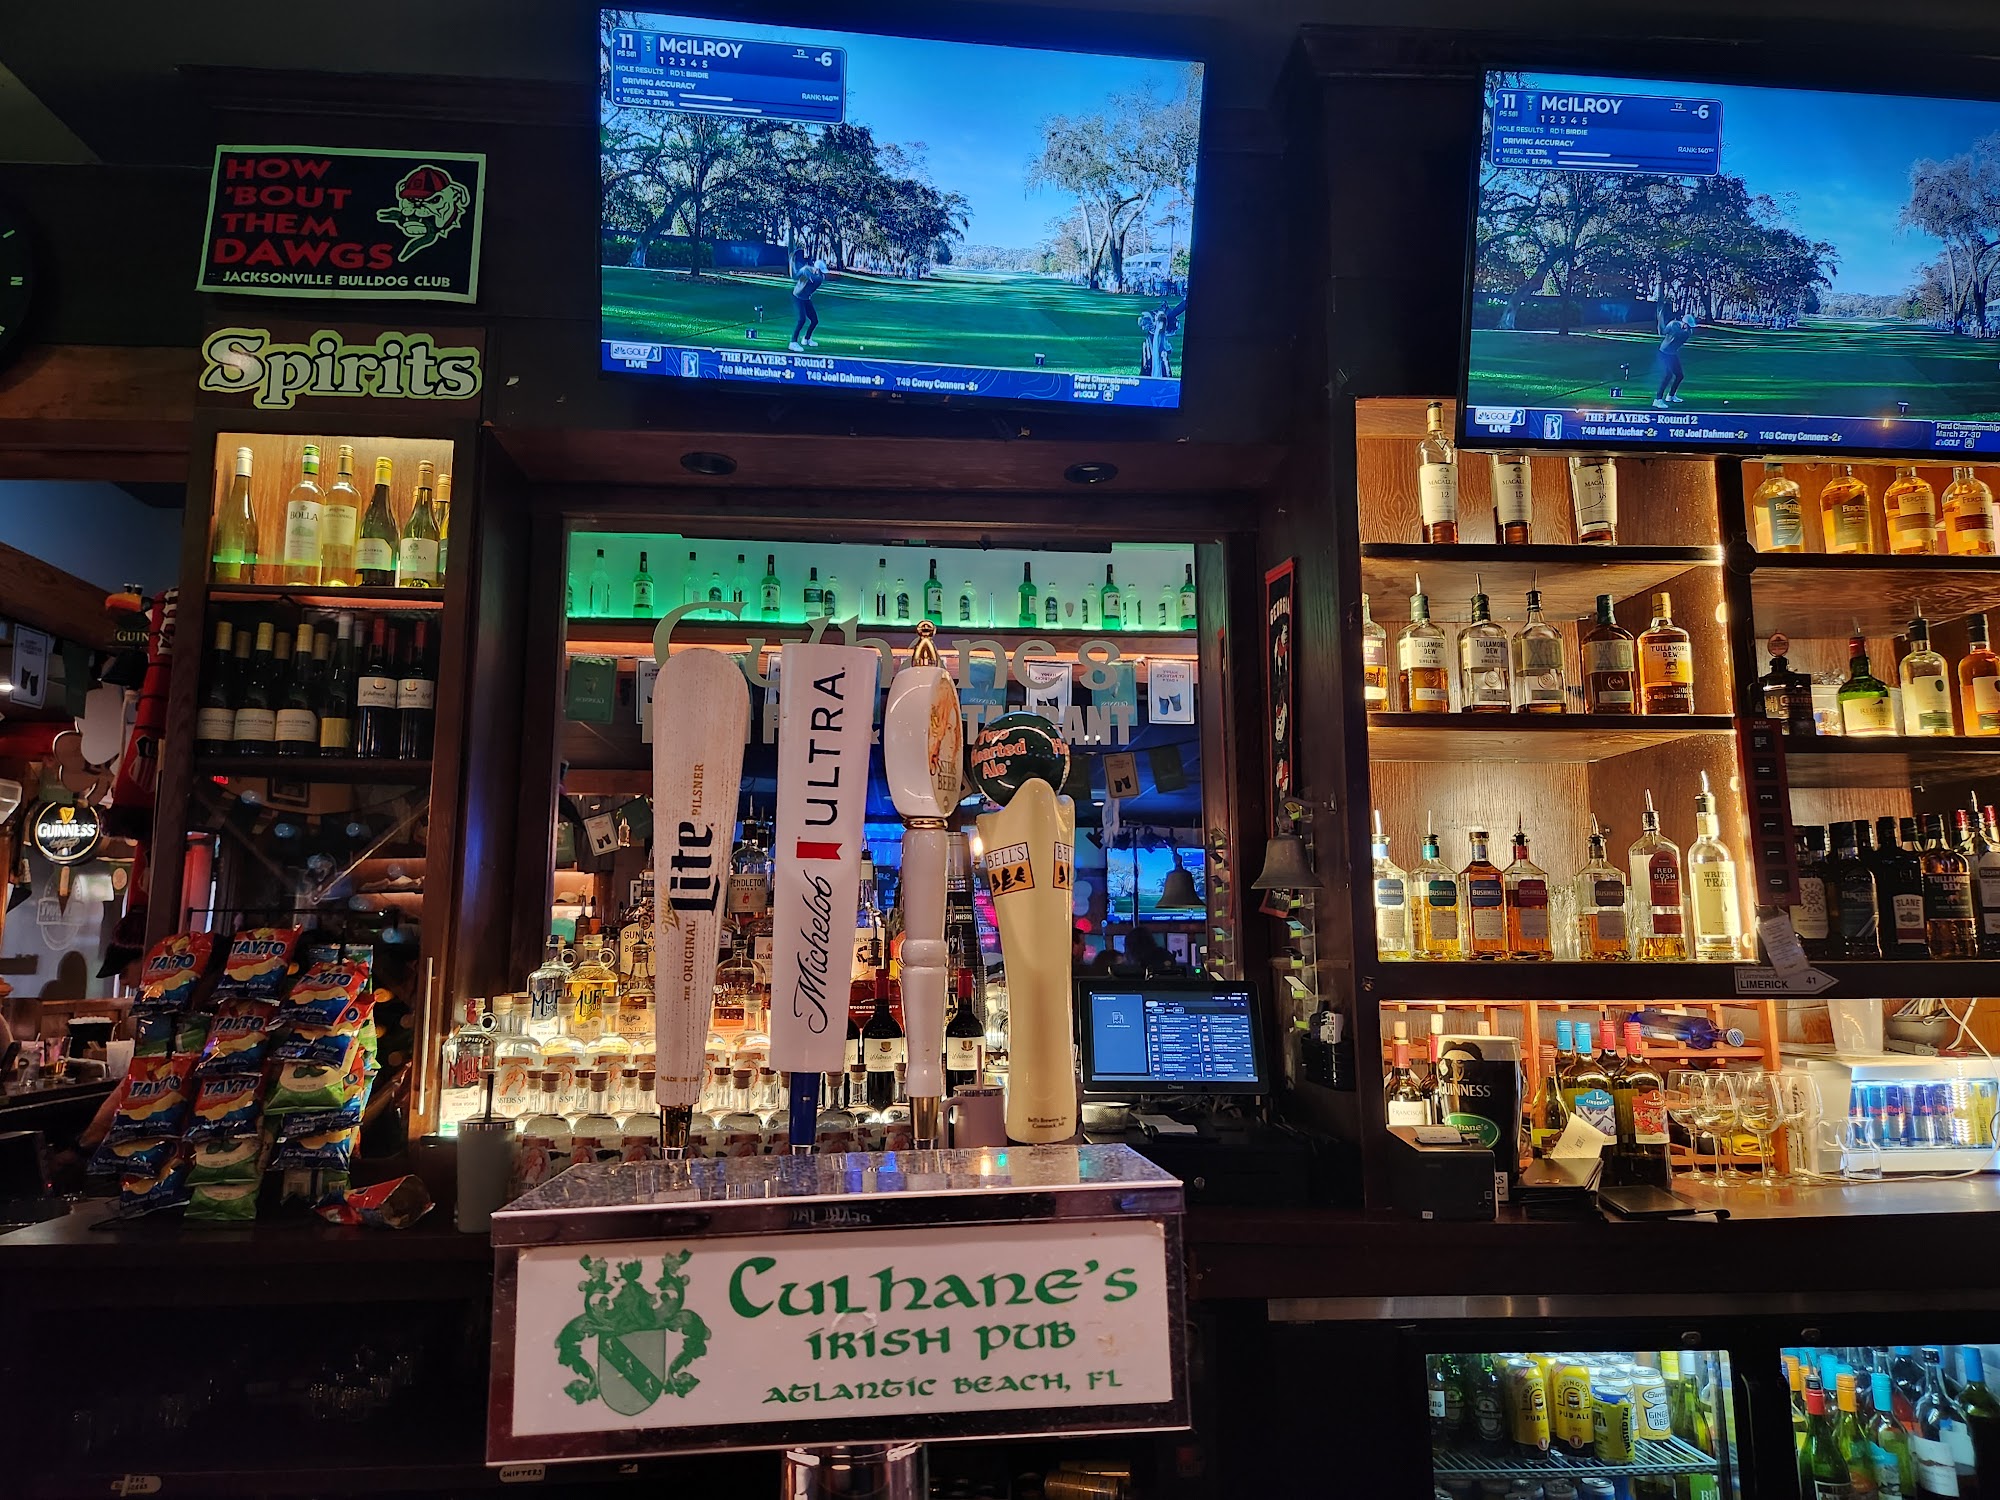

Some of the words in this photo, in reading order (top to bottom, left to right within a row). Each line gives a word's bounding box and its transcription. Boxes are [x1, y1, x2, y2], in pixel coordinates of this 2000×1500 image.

[618, 33, 634, 50] 11
[659, 36, 743, 59] McILROY
[814, 52, 833, 67] -6
[616, 65, 634, 73] HOLE
[635, 66, 664, 76] RESULTS
[686, 71, 709, 79] BIRDIE
[622, 77, 654, 87] DRIVING
[654, 79, 696, 90] ACCURACY
[1502, 94, 1516, 110] 11
[1541, 96, 1623, 115] McILROY
[1692, 104, 1710, 120] -6
[1516, 126, 1544, 134] RESULTS
[1566, 128, 1588, 136] BIRDIE
[1502, 137, 1534, 146] DRIVING
[1534, 138, 1574, 148] ACCURACY
[226, 158, 332, 181] HOW
[224, 186, 352, 210] 'BOUT
[221, 212, 338, 237] THEM
[213, 238, 394, 270] DAWGS
[222, 271, 333, 286] JACKSONVILLE
[338, 274, 408, 288] BULLDOG
[414, 275, 451, 288] CLUB
[626, 347, 648, 357] GOLF
[626, 360, 648, 370] LIVE
[721, 352, 742, 363] THE
[743, 353, 787, 366] PLAYERS
[794, 357, 825, 369] Round
[827, 360, 834, 370] 2
[203, 334, 478, 405] Spirits
[718, 364, 734, 375] T49
[734, 365, 754, 376] Matt
[754, 366, 782, 379] Kuchar
[806, 370, 822, 381] T49
[896, 376, 911, 386] T49
[912, 377, 934, 389] Corey
[1074, 381, 1096, 390] March
[1490, 412, 1512, 422] GOLF
[1584, 412, 1604, 422] THE
[1606, 412, 1650, 424] PLAYERS
[1657, 414, 1690, 425] Round
[1690, 416, 1698, 425] 2
[1489, 424, 1512, 434] LIVE
[1581, 426, 1596, 436] T49
[1597, 426, 1616, 436] Matt
[1616, 427, 1644, 438] Kuchar
[1936, 422, 1953, 430] Ford
[1669, 428, 1684, 438] T49
[1760, 432, 1774, 440] T49
[1774, 432, 1797, 442] Corey
[1936, 430, 1960, 438] March
[290, 510, 318, 522] BOLLA
[116, 630, 150, 642] GUIN
[1414, 640, 1444, 649] TULLAMORE
[1476, 640, 1506, 649] TULLAMORE
[978, 729, 1010, 745] Two
[805, 671, 846, 826] ULTRA
[982, 760, 1008, 780] Ale
[692, 763, 704, 816] PILSNER
[37, 822, 97, 838] GUINNESS
[670, 821, 721, 916] Lite
[730, 878, 766, 888] PENDLETON
[1378, 888, 1404, 896] BUSHMILLS
[1429, 889, 1456, 897] BUSHMILLS
[1472, 888, 1502, 896] BUSHMILLS
[1518, 888, 1546, 896] BUSHMILLS
[1896, 900, 1920, 908] SLANE
[231, 940, 286, 956] TAYTO
[683, 919, 696, 982] ORIGINAL
[794, 870, 834, 1034] Michelob
[1740, 980, 1789, 989] LIMERICK
[1806, 976, 1816, 984] 41
[130, 1076, 182, 1098] TAYTO
[203, 1076, 262, 1098] TAYTO
[1440, 1082, 1491, 1098] GUINNESS
[728, 1256, 1139, 1320] Culhane's
[805, 1324, 951, 1361] IRISH
[974, 1320, 1077, 1360] PUB
[762, 1374, 938, 1405] ATLANTIC
[952, 1372, 1071, 1396] BEACH,
[1088, 1369, 1123, 1393] FL
[1525, 1414, 1541, 1422] PUB
[1558, 1410, 1574, 1420] PUB
[1622, 1420, 1632, 1454] TWISTED
